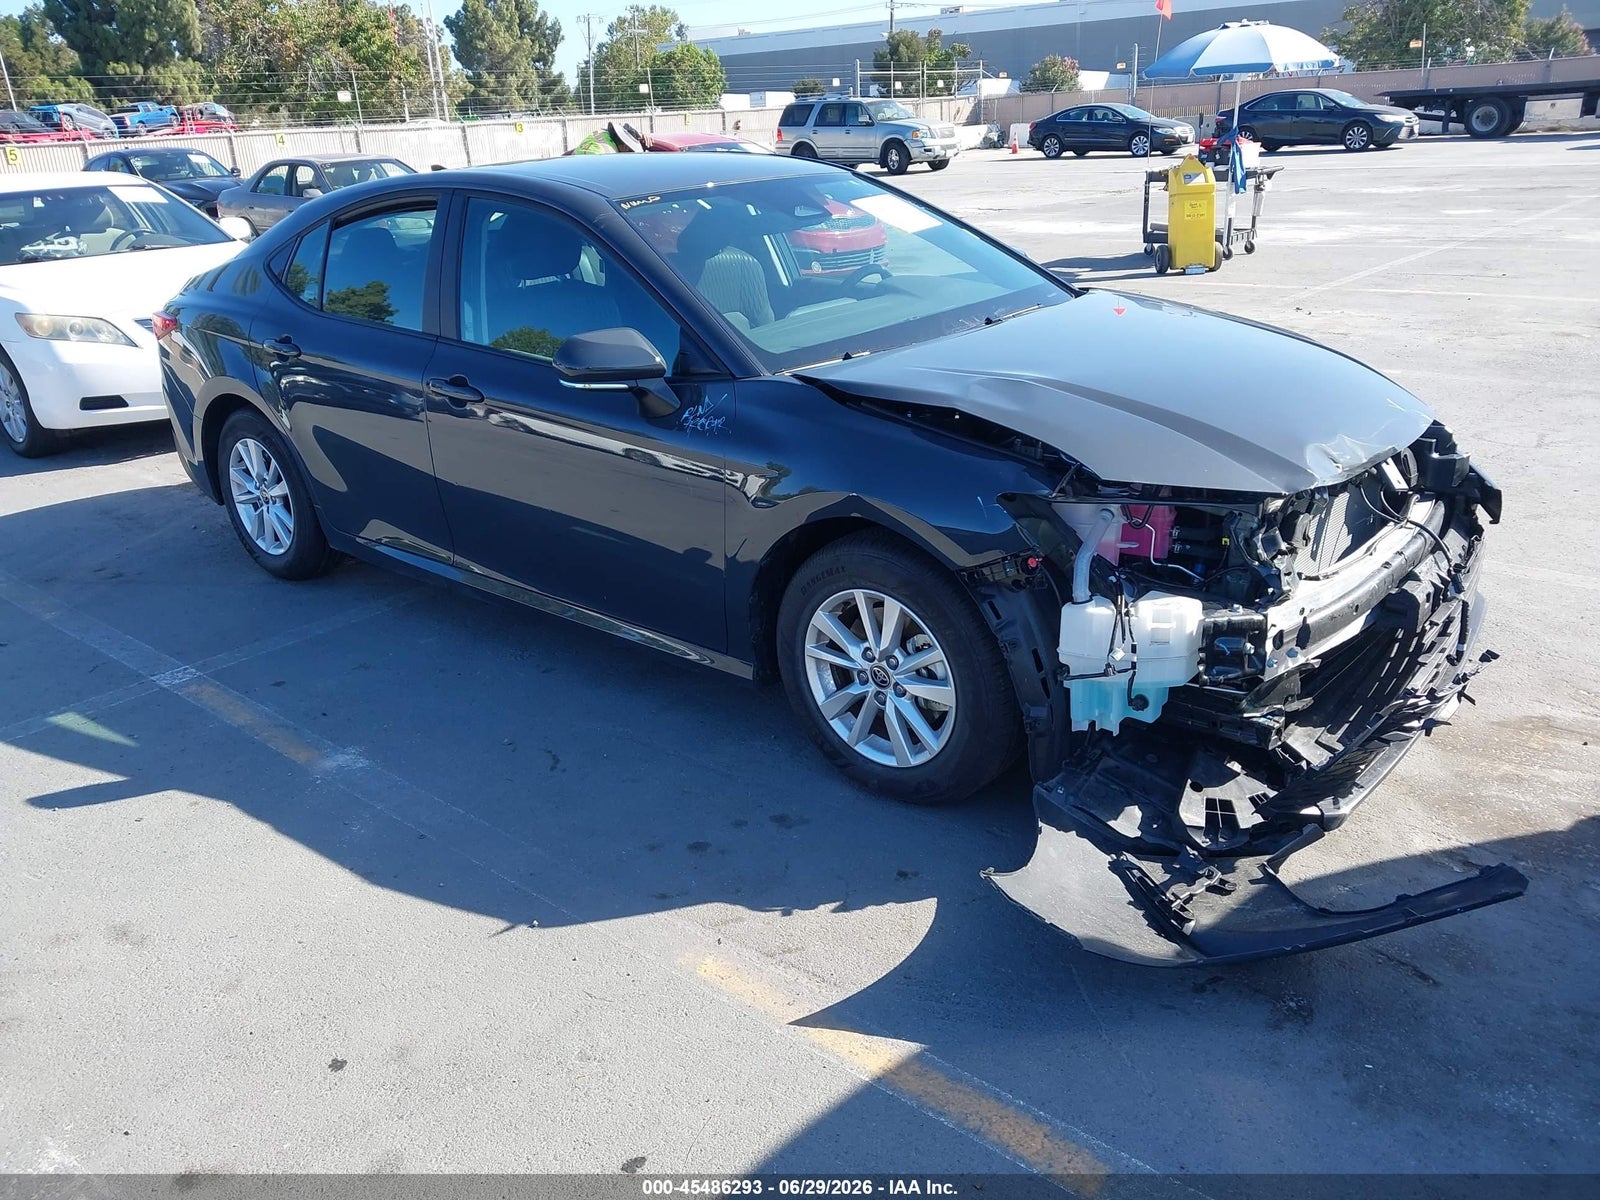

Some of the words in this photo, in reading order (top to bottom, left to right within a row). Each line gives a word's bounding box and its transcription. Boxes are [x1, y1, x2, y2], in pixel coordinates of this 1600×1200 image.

[517, 123, 524, 133] 3
[278, 135, 285, 146] 4
[9, 149, 18, 161] 5
